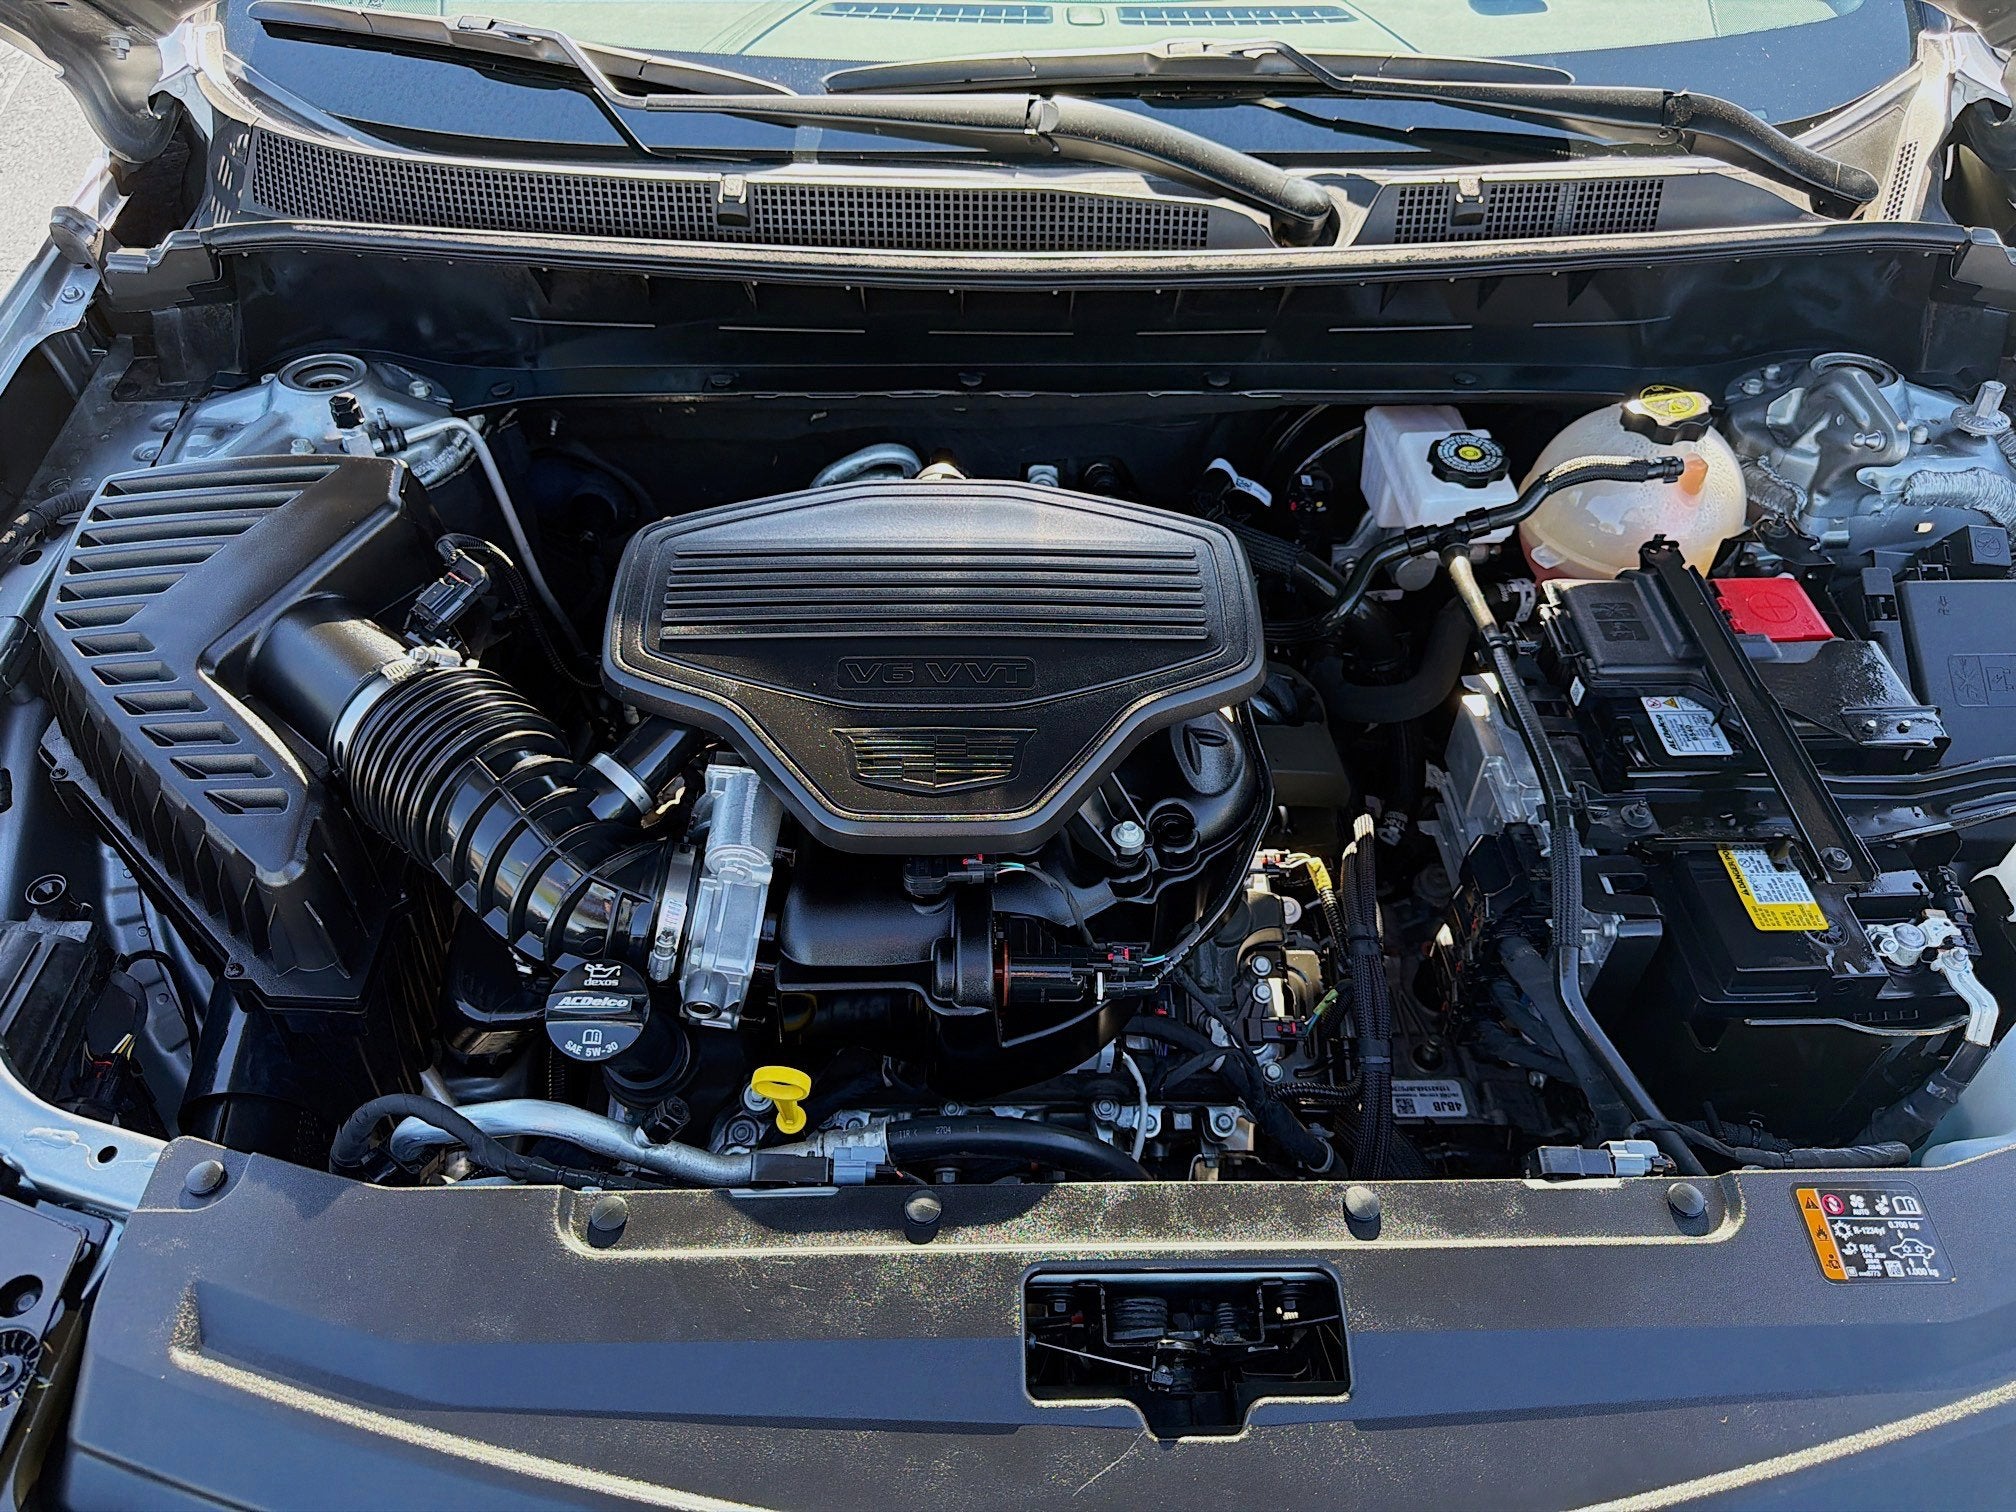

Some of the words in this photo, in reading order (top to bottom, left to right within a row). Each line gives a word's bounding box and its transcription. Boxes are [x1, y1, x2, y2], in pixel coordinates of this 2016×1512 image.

[845, 662, 915, 684] V6
[925, 662, 1028, 684] VVT
[583, 978, 619, 987] dexos
[555, 996, 629, 1008] ACDelco
[564, 1040, 583, 1055] SAE
[585, 1041, 619, 1057] 5W-30
[1432, 1101, 1462, 1112] 4BJB
[1852, 1208, 1870, 1216] AUTO
[1907, 1220, 1920, 1231] kg
[1858, 1244, 1877, 1253] PAG
[1927, 1268, 1940, 1278] kg
